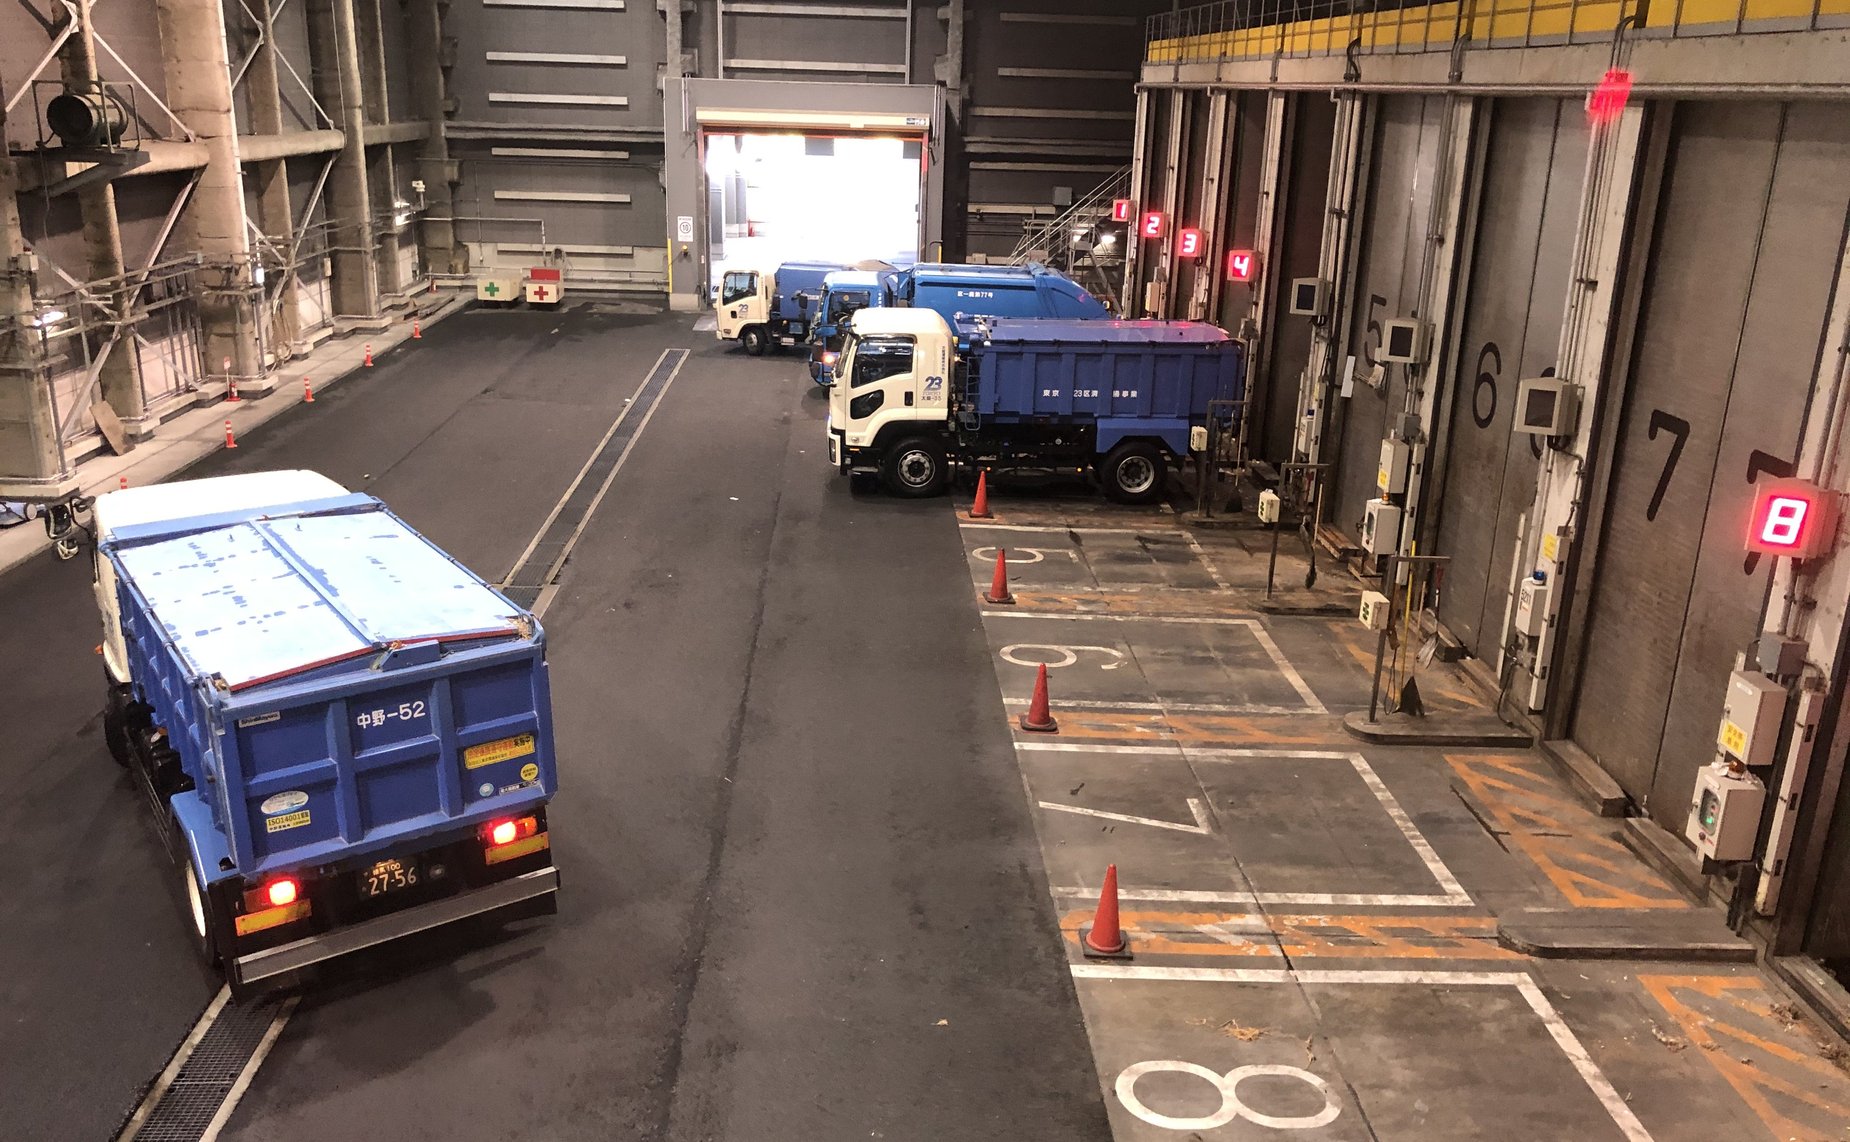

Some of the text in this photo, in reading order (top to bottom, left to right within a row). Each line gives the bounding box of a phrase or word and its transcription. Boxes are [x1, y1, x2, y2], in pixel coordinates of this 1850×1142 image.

[1146, 216, 1160, 234] 2
[1182, 233, 1198, 253] 3
[1233, 255, 1250, 277] 4
[1364, 294, 1387, 367] 5
[924, 376, 943, 391] 23
[1472, 342, 1502, 430] 6
[1646, 409, 1691, 522] 7
[1761, 497, 1808, 545] 8
[972, 546, 1080, 564] 5
[1000, 643, 1128, 672] 6
[357, 700, 426, 729] 中野-52
[1038, 798, 1212, 834] 7
[368, 866, 417, 896] 27-56
[1114, 1059, 1343, 1130] 8
